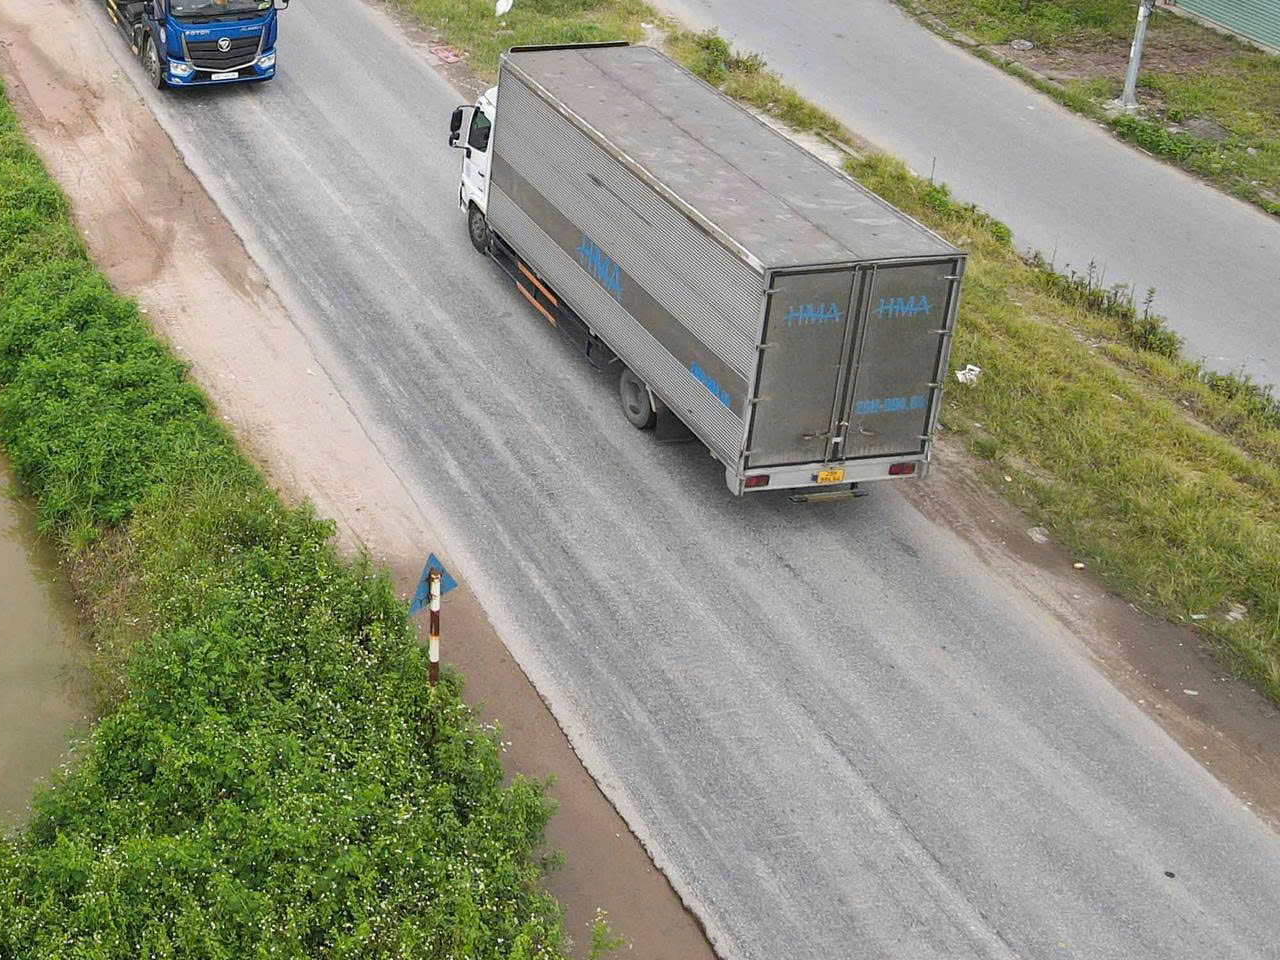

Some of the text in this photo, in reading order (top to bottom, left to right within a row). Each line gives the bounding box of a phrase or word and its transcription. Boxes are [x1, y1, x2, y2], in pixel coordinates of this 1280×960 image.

[576, 233, 624, 302] HMA
[784, 303, 844, 327] HMA
[872, 295, 933, 320] HMA
